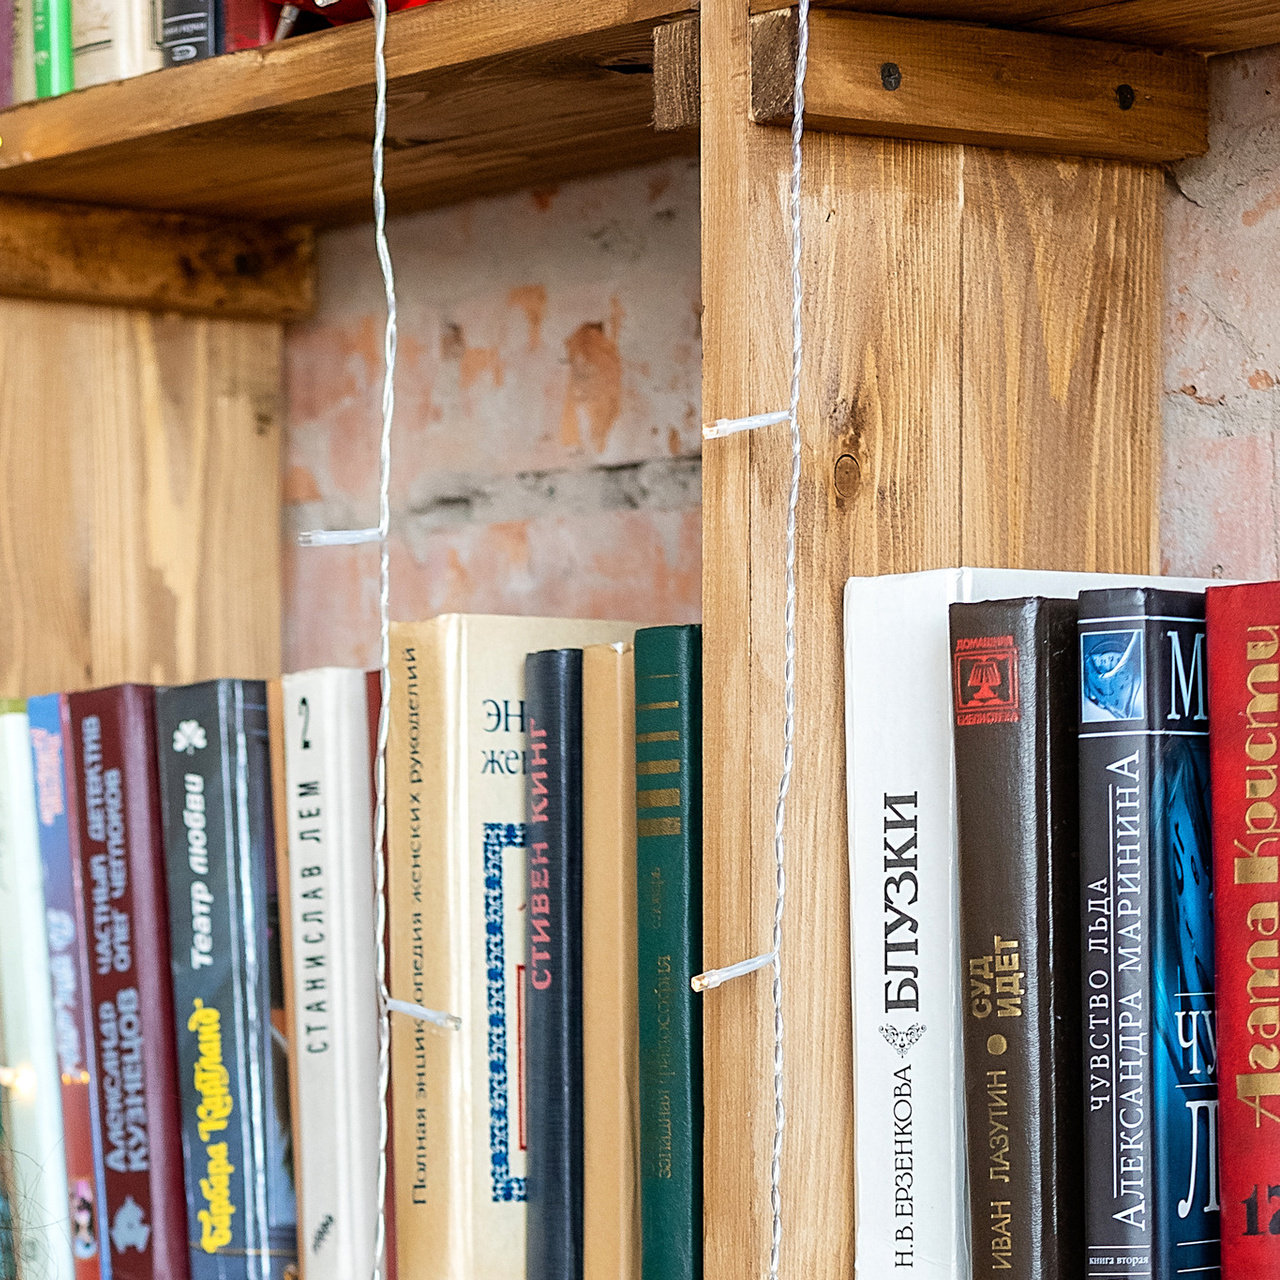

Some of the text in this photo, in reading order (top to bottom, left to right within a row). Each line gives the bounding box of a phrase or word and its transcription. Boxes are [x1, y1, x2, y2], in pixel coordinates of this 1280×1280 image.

[1166, 630, 1208, 721] М
[183, 773, 215, 970] Театр любви
[297, 779, 329, 1054] СТАНИСЛАВ ЛЕМ
[404, 646, 428, 1205] Полная энцикопедия женских рукоделий
[530, 717, 552, 991] СТИВЕН КИНГ
[884, 790, 919, 1014] БЛУЗКИ
[1233, 624, 1280, 1128] Агата Кристи
[969, 954, 994, 1020] СУД
[993, 934, 1023, 1018] ИДЕТ
[1087, 876, 1111, 1112] ЧУВСТВО ЛЬДА
[1106, 749, 1149, 1232] АЛЕКСАНДРА МАРИНИНА
[893, 1064, 913, 1216] ЕРЗЕНКОВА
[986, 1069, 1013, 1270] ИВАН ЛАЗУТИН
[1088, 1254, 1150, 1268] книга вторая
